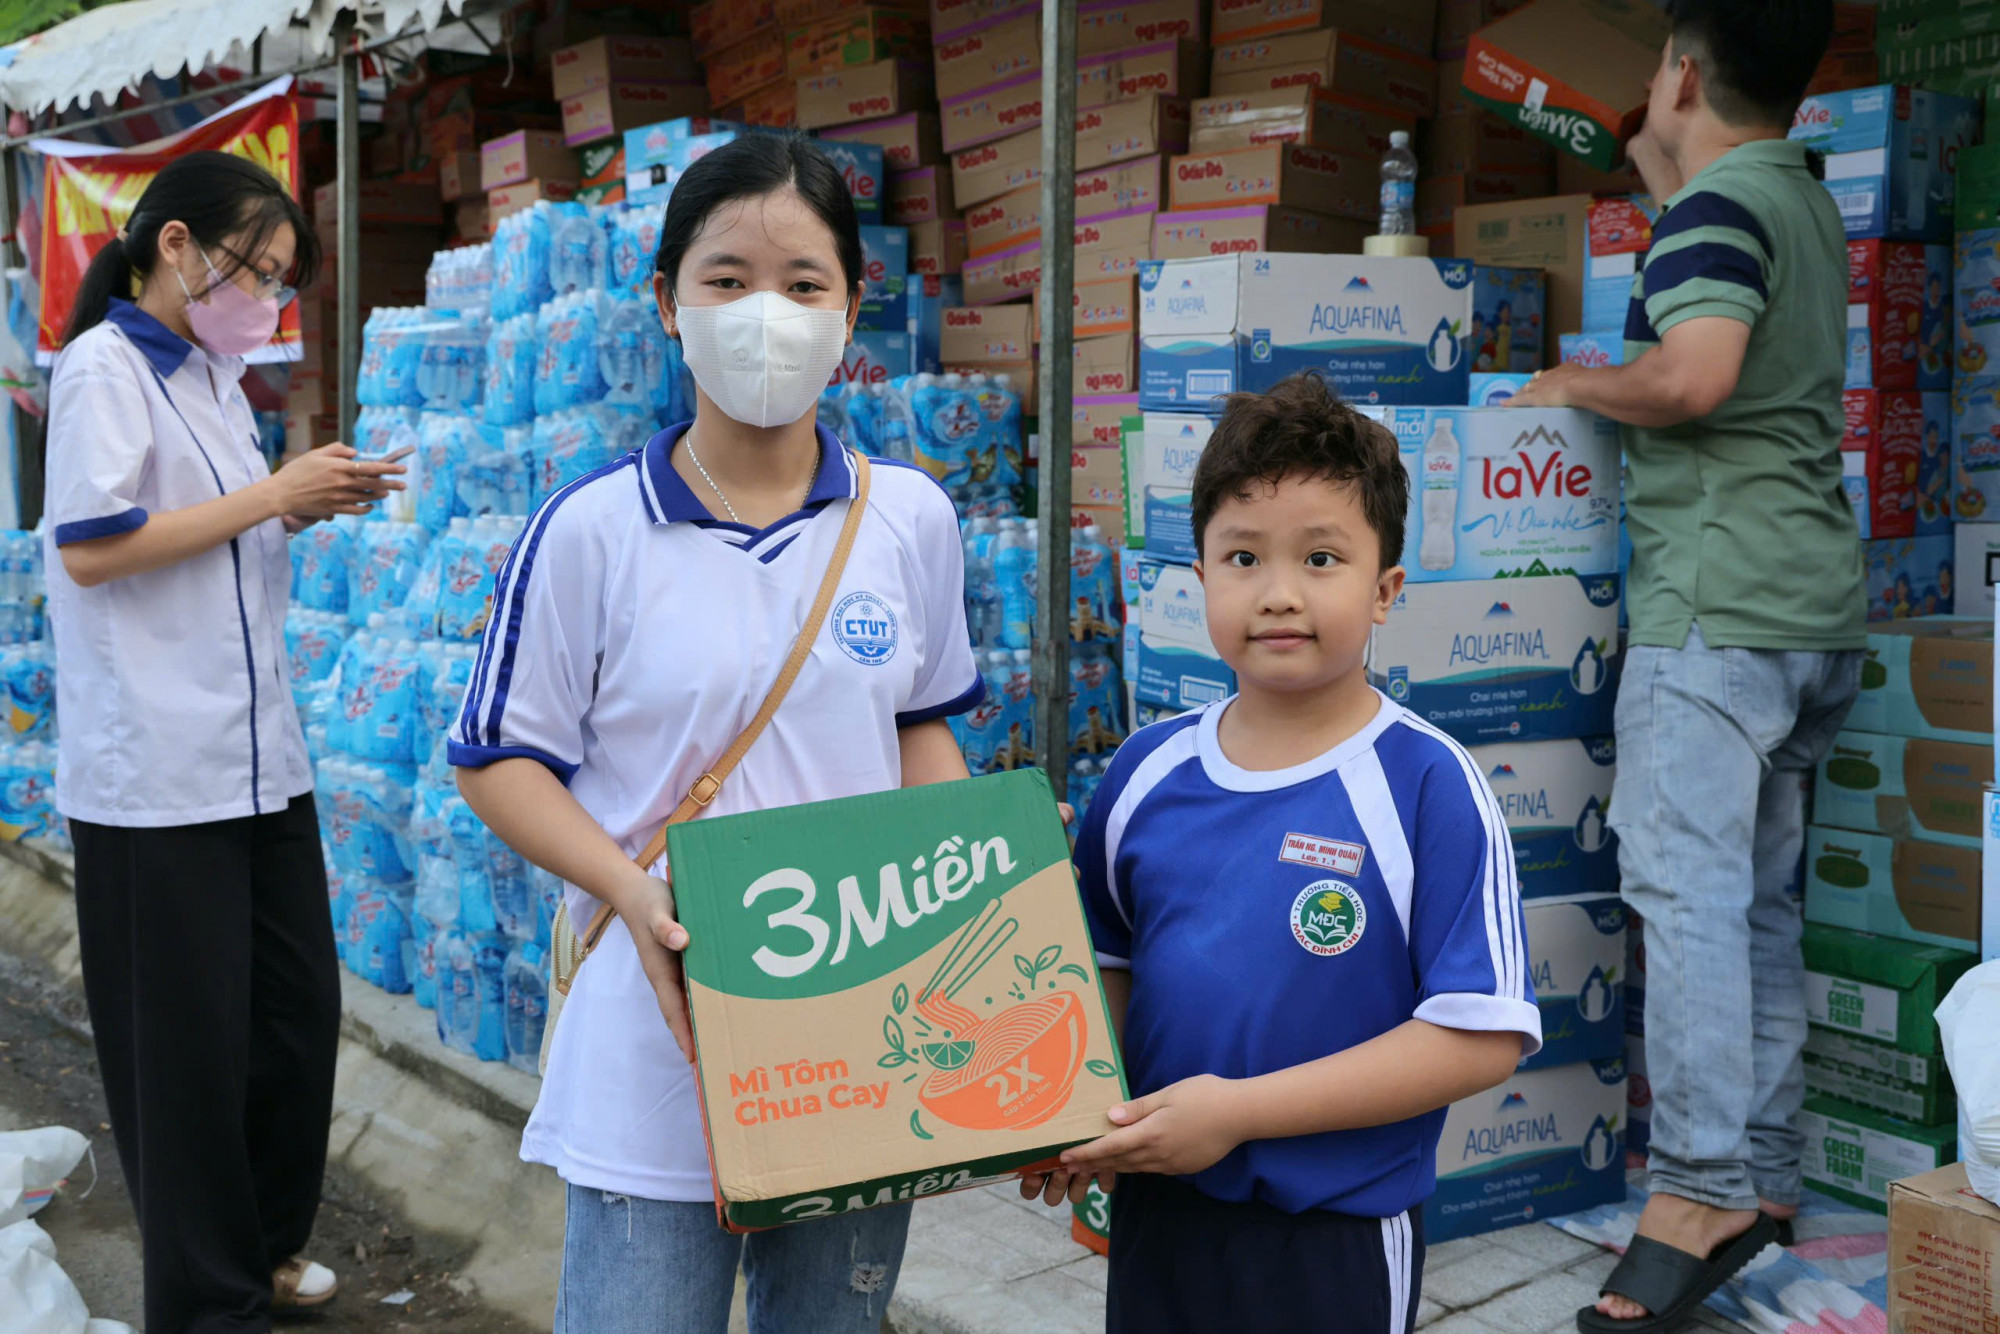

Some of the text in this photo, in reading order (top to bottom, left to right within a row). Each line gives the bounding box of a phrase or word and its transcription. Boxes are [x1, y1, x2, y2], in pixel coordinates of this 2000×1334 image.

[1255, 259, 1270, 271] 24
[1309, 303, 1405, 335] AQUAFINA
[1395, 419, 1425, 435] mới
[1483, 451, 1592, 500] laVie
[845, 619, 888, 637] CTUT
[1449, 628, 1545, 667] AQUAFINA
[1318, 845, 1337, 857] MINH
[742, 867, 830, 978] 3
[1343, 933, 1359, 949] CHI
[1828, 990, 1864, 1012] GREEN
[1829, 1007, 1862, 1028] FARM
[729, 1057, 849, 1098] Mì Tôm
[984, 1055, 1045, 1108] 2X
[734, 1081, 890, 1127] Chua Cay
[1463, 1113, 1557, 1161] AQUAFINA
[1824, 1137, 1864, 1163] GREEN
[1826, 1156, 1862, 1182] FARM
